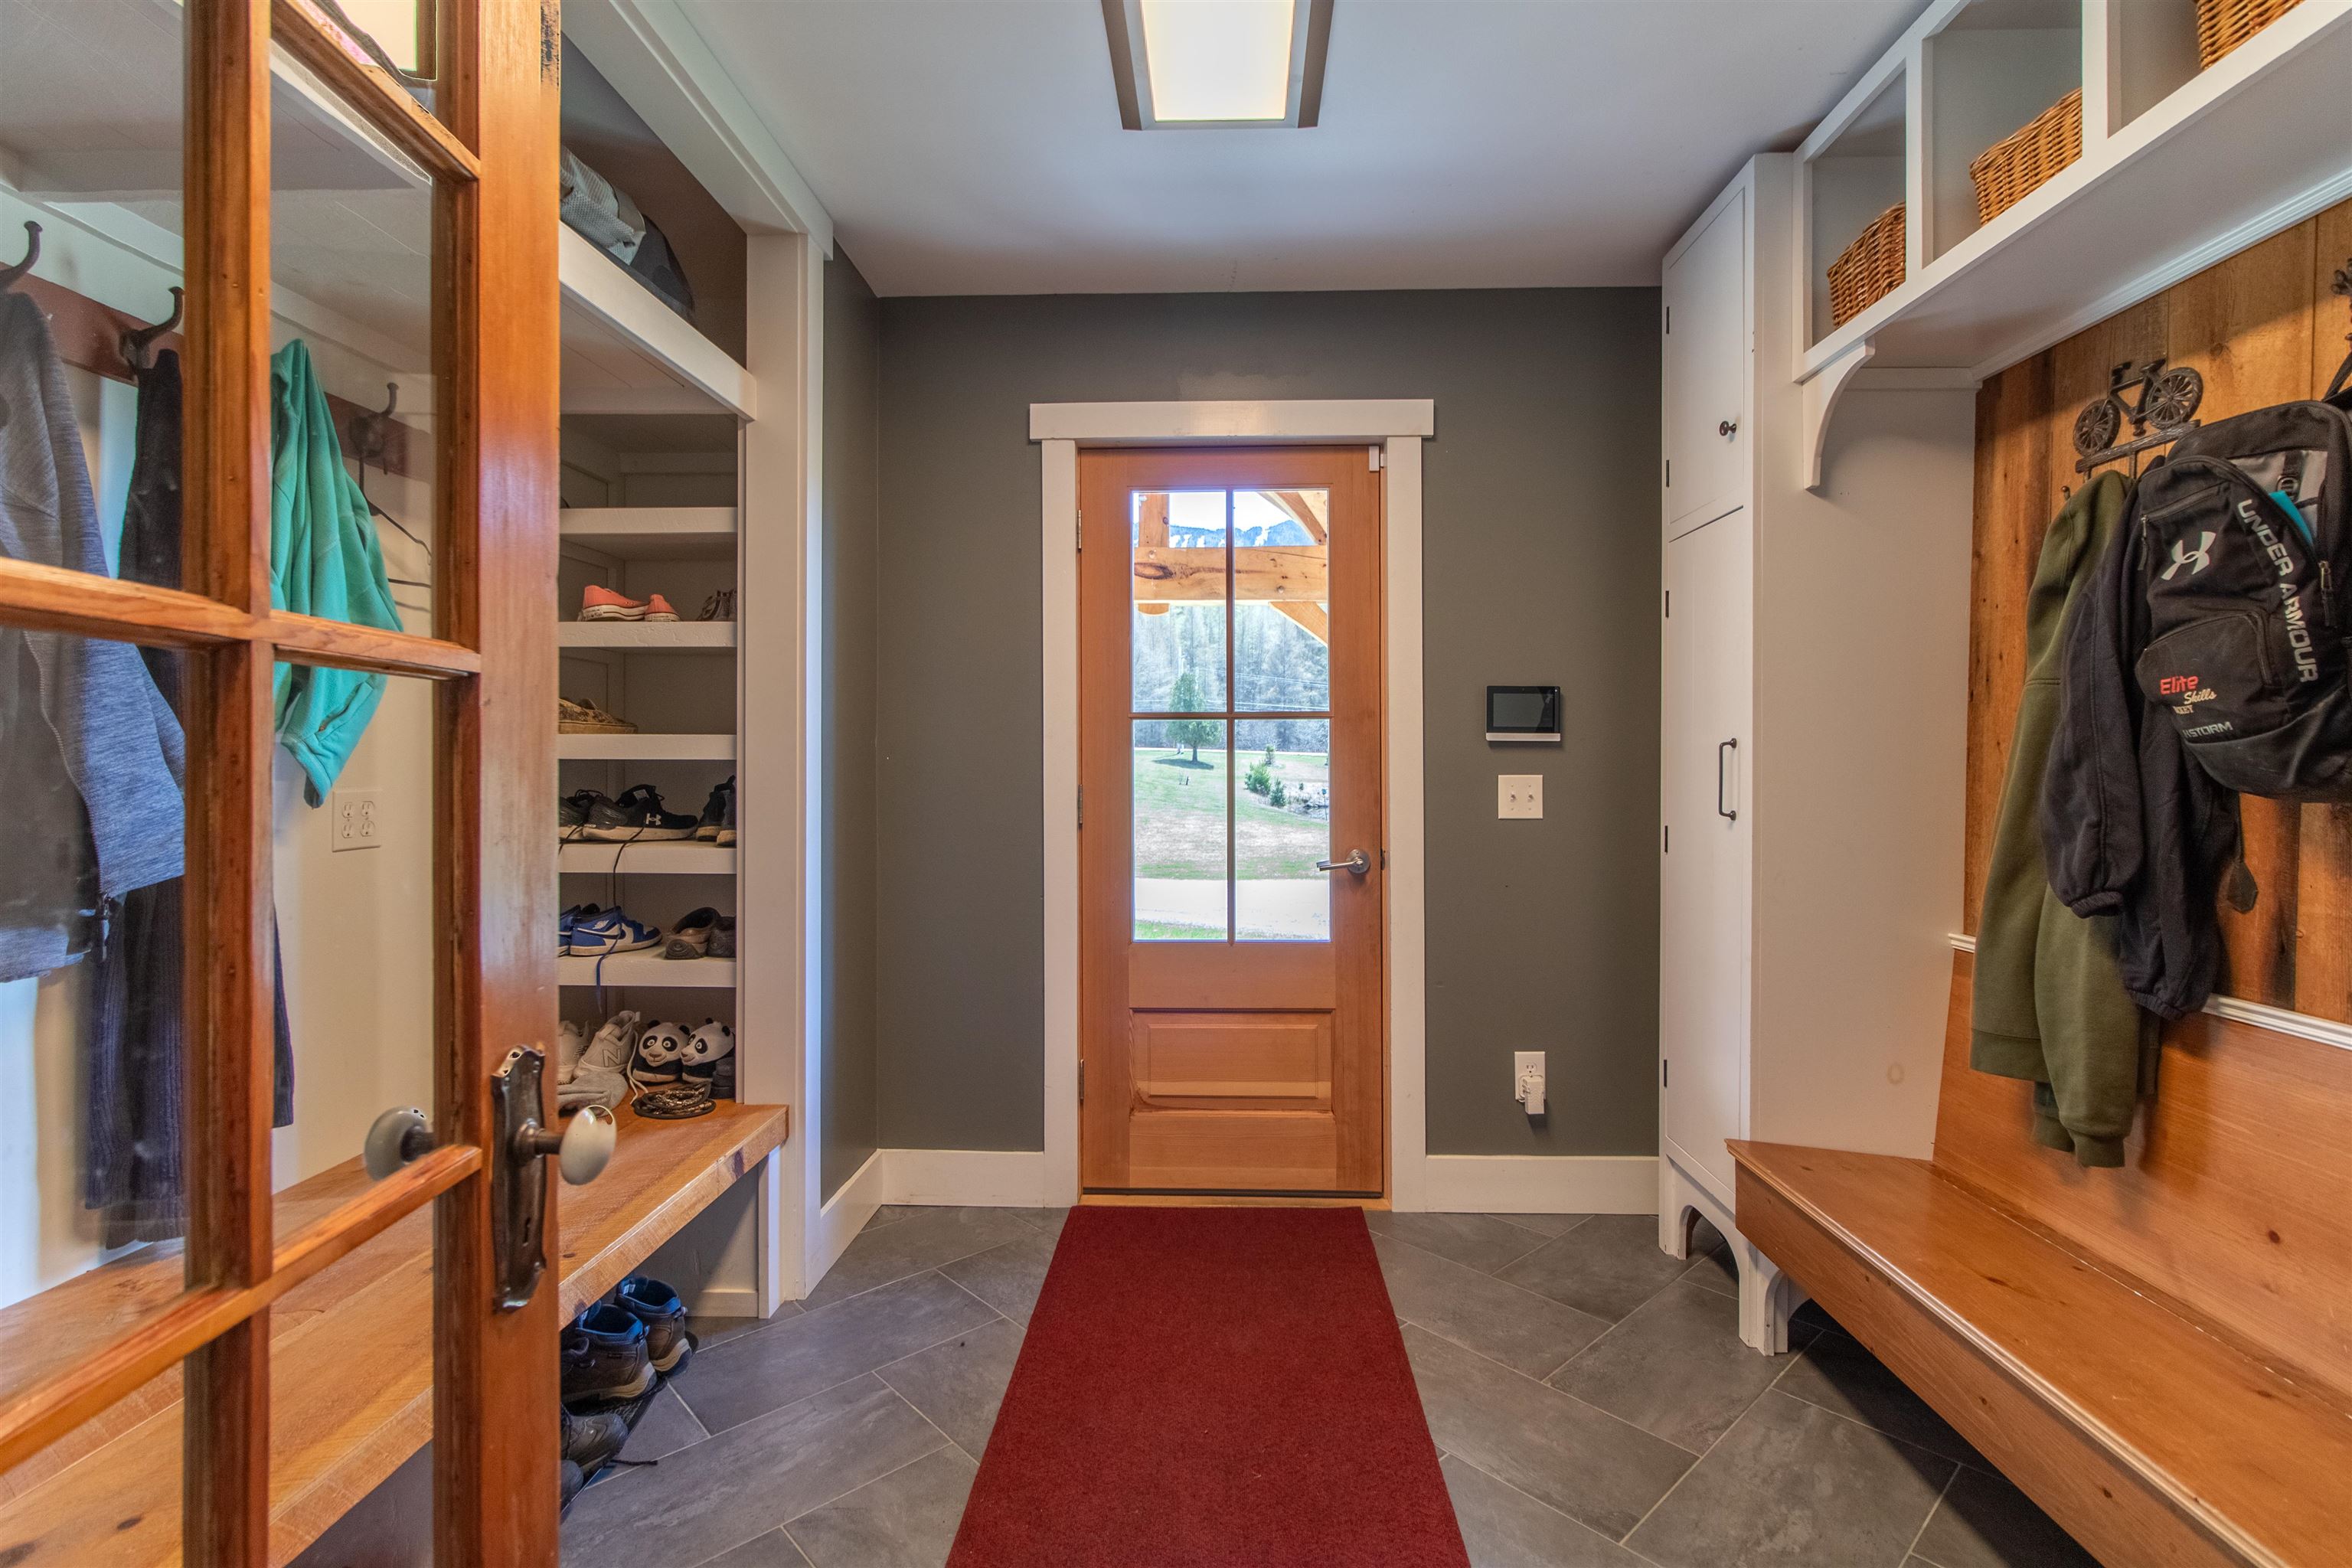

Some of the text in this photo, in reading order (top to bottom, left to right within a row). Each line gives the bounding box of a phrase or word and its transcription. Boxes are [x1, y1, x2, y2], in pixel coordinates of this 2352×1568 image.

[2237, 498, 2319, 683] UNDER ARMOUR
[2160, 675, 2199, 695] Elite
[2184, 688, 2217, 704] Skills
[2188, 721, 2234, 738] STORM
